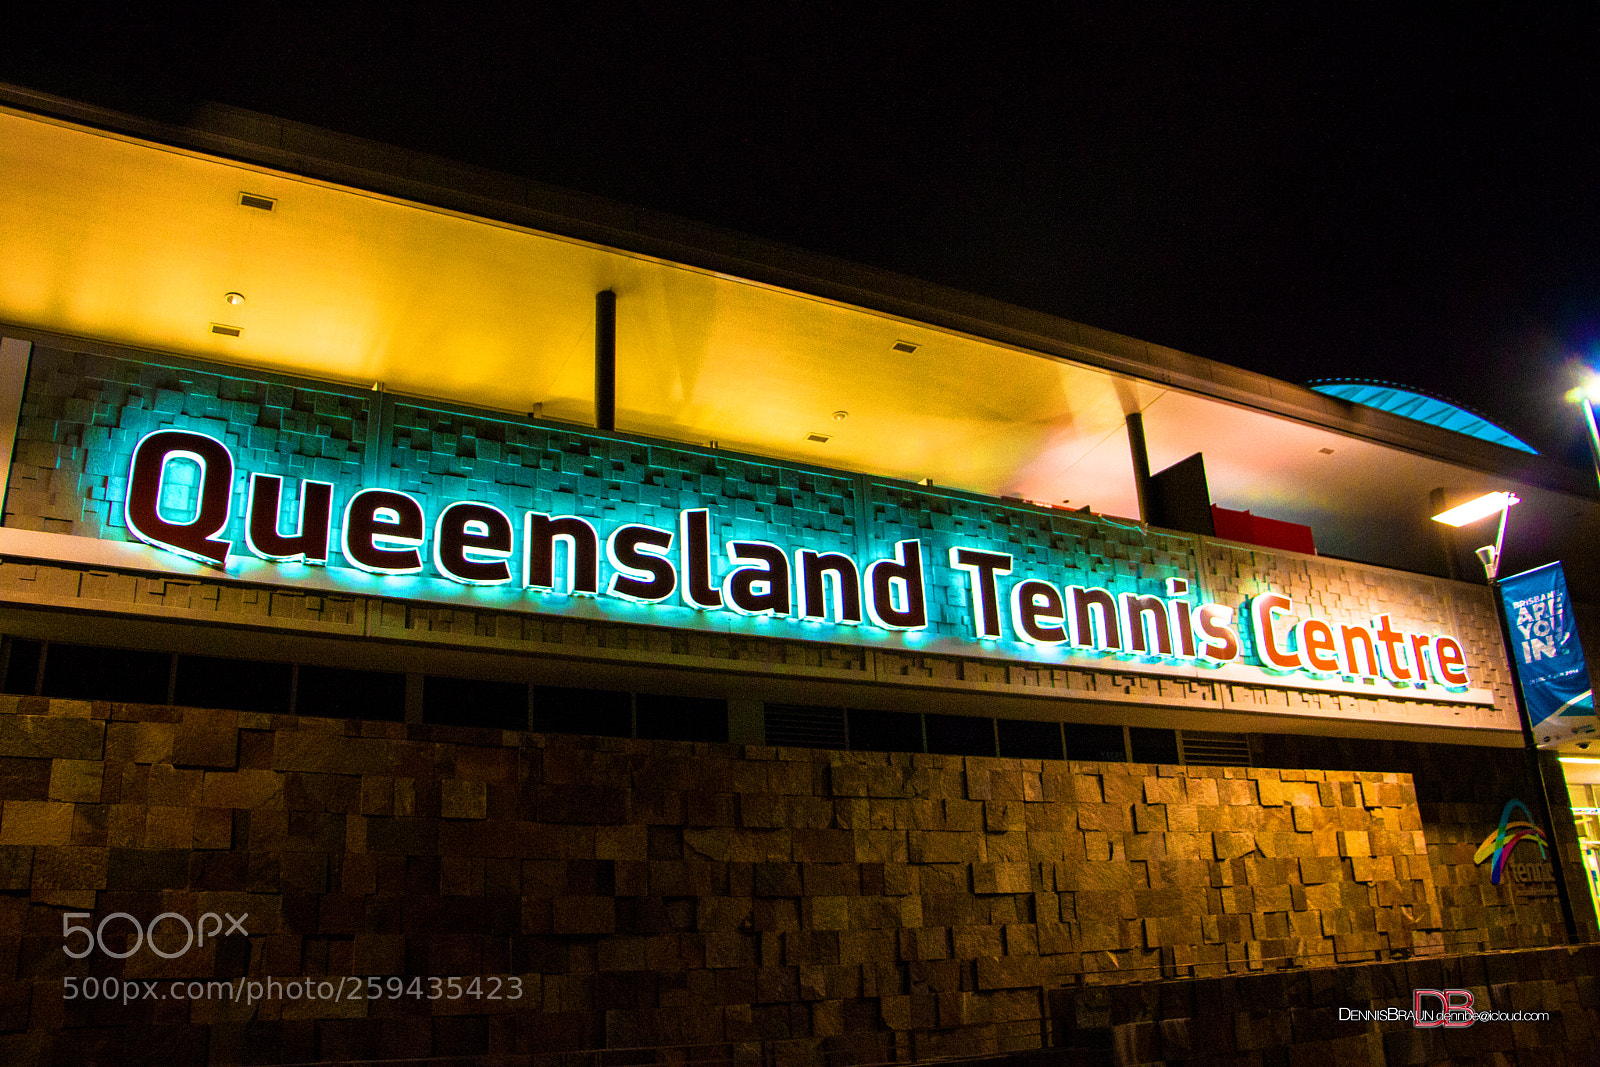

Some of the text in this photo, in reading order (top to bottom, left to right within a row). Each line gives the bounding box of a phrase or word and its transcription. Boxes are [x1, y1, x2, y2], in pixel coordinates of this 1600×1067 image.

[125, 429, 1471, 690] Queensland Tennis Centre
[1517, 597, 1564, 625] ARE
[1518, 614, 1564, 641] YOU
